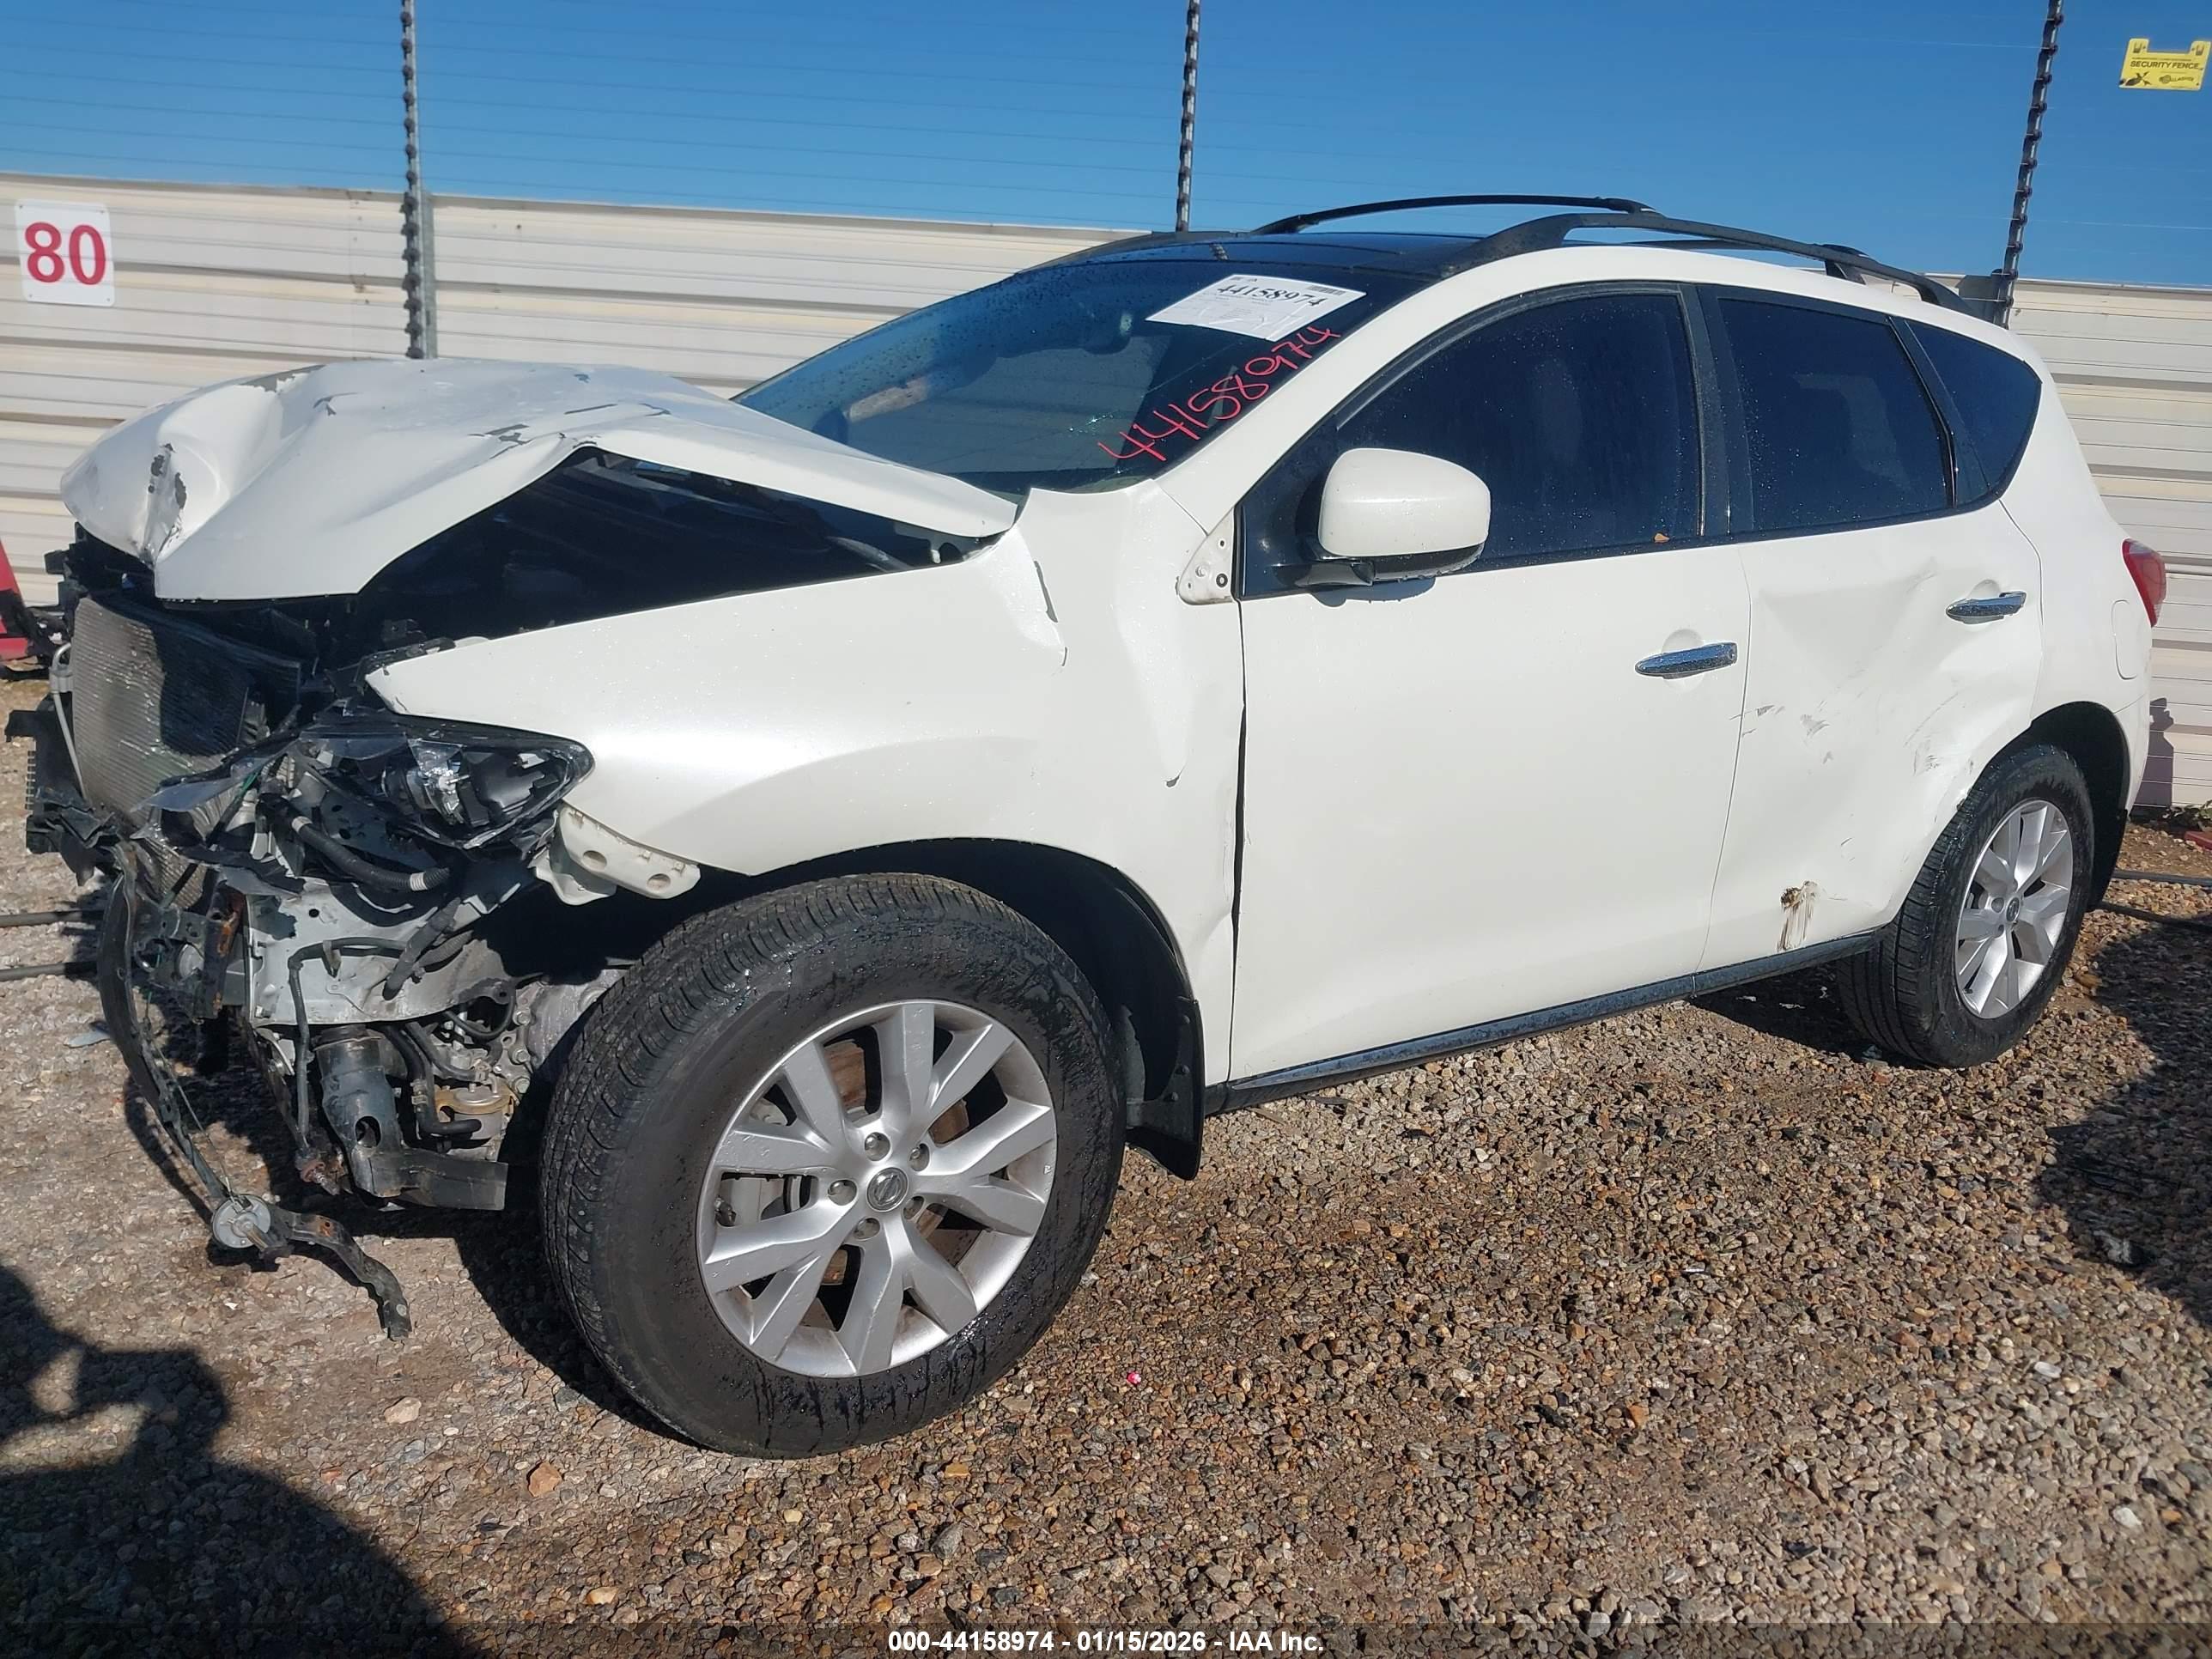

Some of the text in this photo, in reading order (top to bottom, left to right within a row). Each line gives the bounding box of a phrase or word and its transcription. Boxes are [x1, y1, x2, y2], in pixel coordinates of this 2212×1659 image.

[2130, 60, 2172, 69] SECURITY
[25, 222, 106, 285] 80
[1217, 284, 1328, 307] 44158974
[1097, 325, 1341, 461] 44158974
